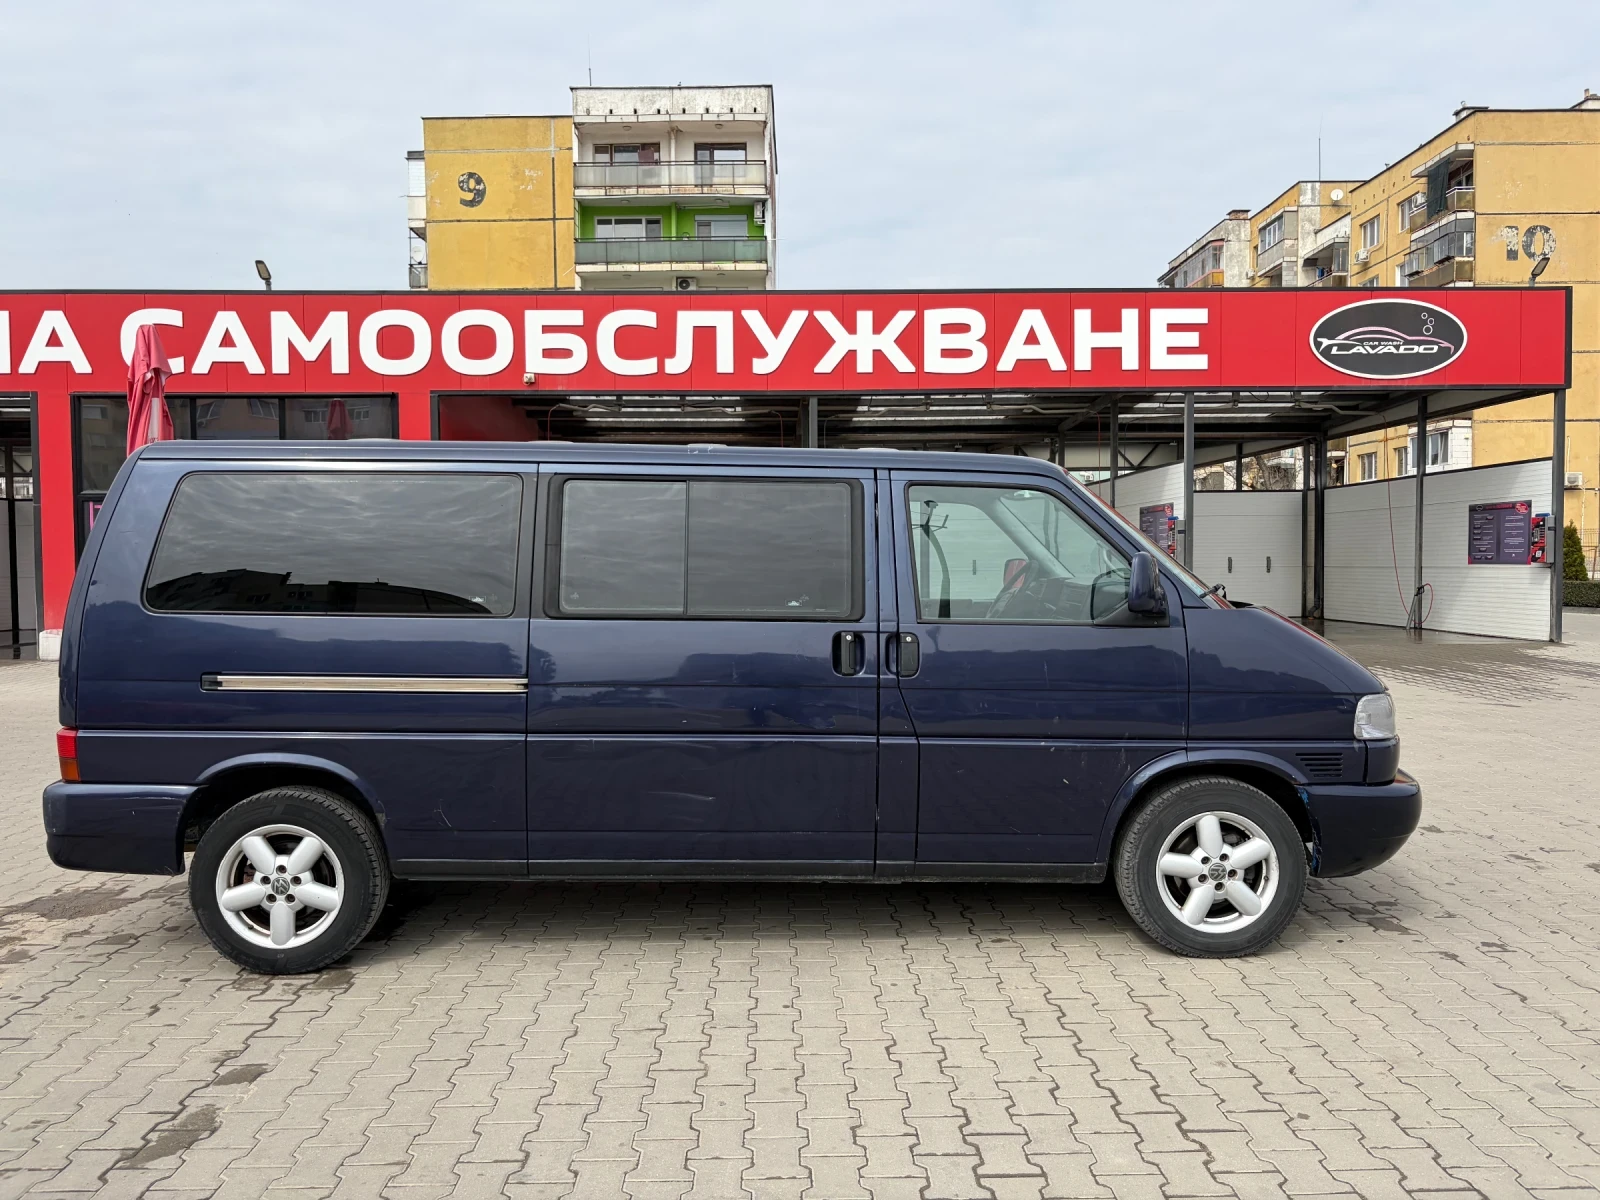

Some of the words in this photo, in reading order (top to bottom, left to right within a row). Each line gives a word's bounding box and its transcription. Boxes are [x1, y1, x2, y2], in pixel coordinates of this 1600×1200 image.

[458, 172, 486, 208] 9
[1491, 225, 1557, 261] 10
[0, 310, 93, 374] А
[120, 308, 1209, 376] САМООБСЛУЖВАНЕ
[1331, 345, 1438, 354] LAVADO
